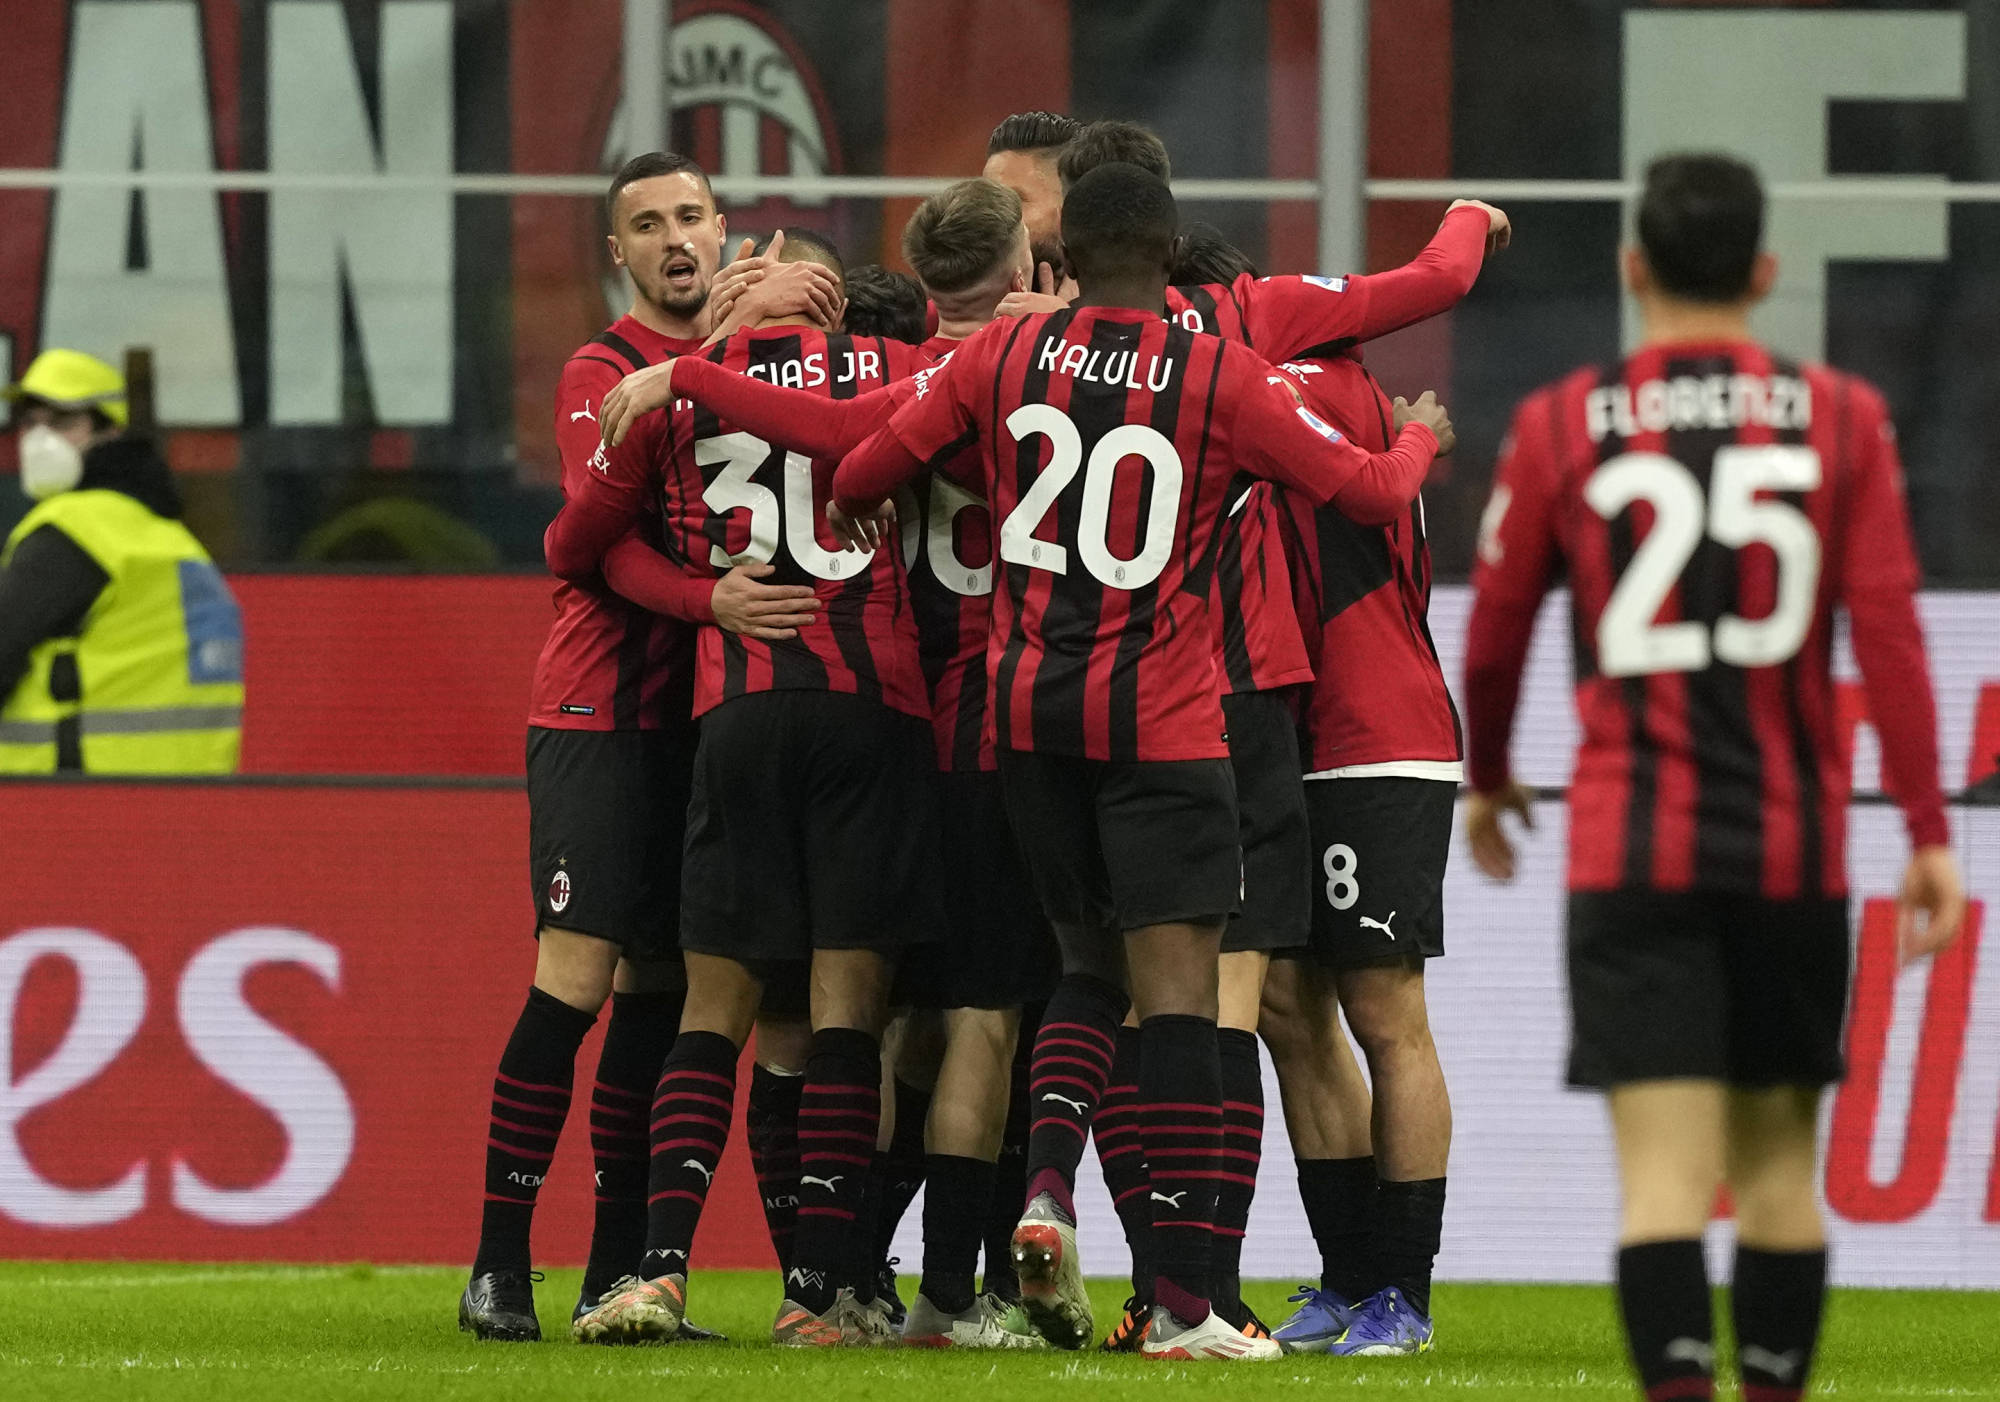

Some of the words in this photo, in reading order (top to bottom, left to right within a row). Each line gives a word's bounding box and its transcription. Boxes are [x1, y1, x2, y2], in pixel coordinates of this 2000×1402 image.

[0, 0, 455, 427] AN
[837, 351, 880, 383] JR
[1037, 335, 1174, 393] KALULU
[1585, 373, 1813, 442] FLORENZI
[694, 431, 877, 581] 30
[1000, 402, 1185, 591] 20
[1584, 444, 1824, 680] 25
[1323, 843, 1360, 911] 8
[0, 925, 356, 1230] es
[1824, 897, 2000, 1223] U
